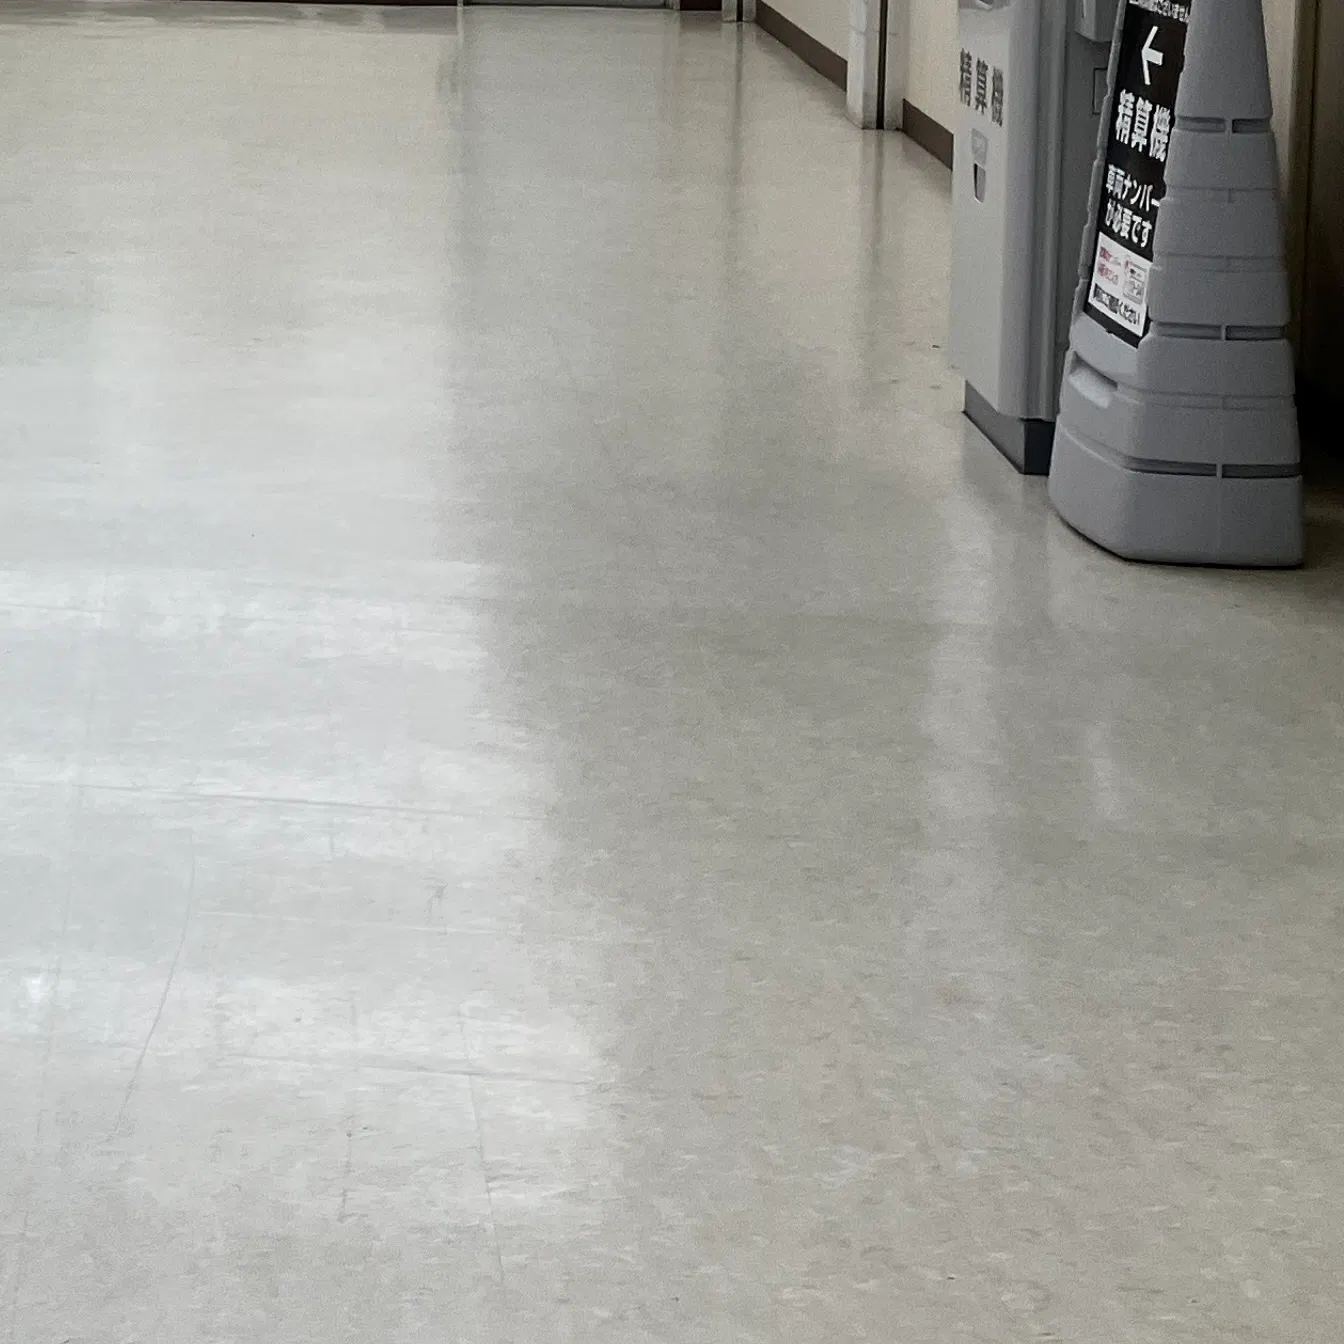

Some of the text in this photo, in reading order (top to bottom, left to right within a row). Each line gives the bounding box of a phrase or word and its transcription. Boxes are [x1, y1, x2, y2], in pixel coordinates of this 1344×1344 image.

[959, 46, 1004, 128] 精算機
[1115, 88, 1171, 162] 精算機
[1105, 163, 1160, 212] 車両ナンバー
[1104, 197, 1153, 248] が必要です
